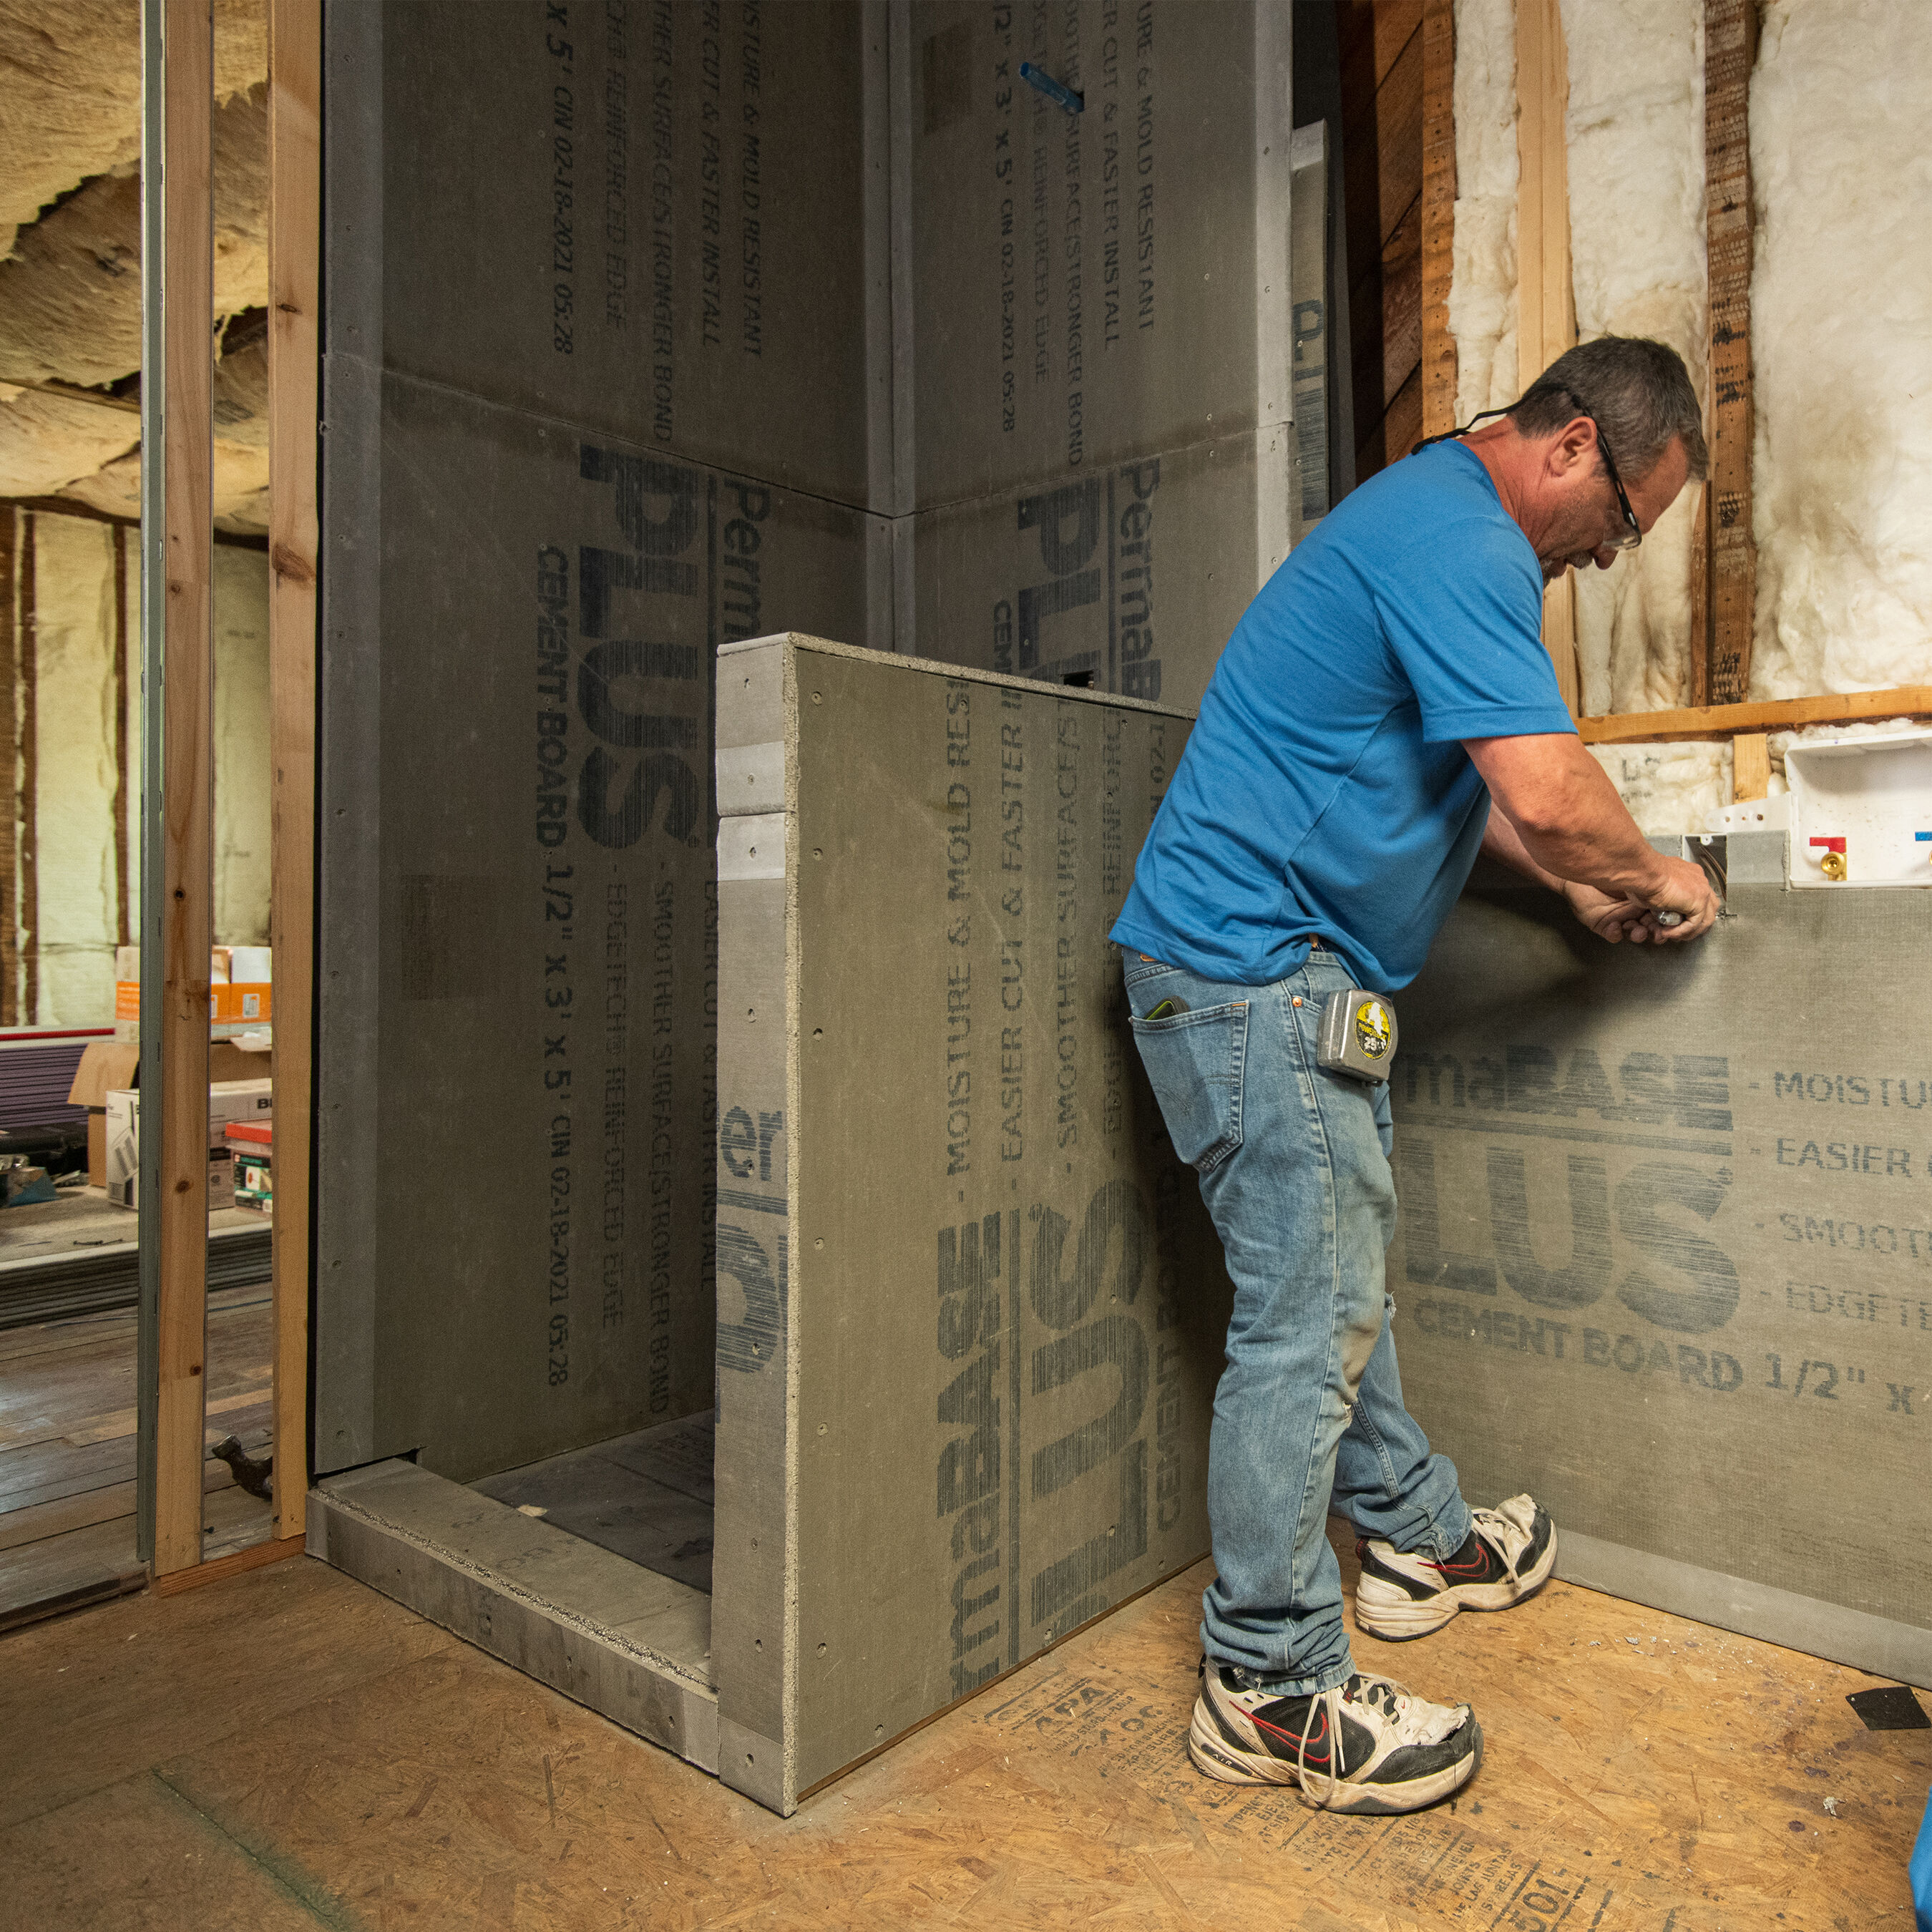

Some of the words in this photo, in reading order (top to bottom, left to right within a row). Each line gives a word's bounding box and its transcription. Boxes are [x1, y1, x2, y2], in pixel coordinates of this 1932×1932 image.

[702, 37, 720, 97] CUT
[743, 0, 761, 99] ISTURE
[1103, 36, 1118, 88] CUT
[702, 130, 721, 236] FASTER
[743, 132, 761, 211] MOLD
[1103, 130, 1119, 234] FASTER
[1137, 94, 1154, 176] MOLD
[554, 136, 573, 273] 02-18-2021
[1136, 182, 1154, 331] RESISTANT
[554, 283, 573, 355] 05:28
[606, 253, 626, 331] EDGE
[702, 240, 721, 348] INSTALL
[743, 216, 761, 358] RESISTANT
[1001, 242, 1015, 362] 02-18-2021
[1103, 240, 1121, 351] INSTALL
[653, 364, 673, 442] BOND
[1002, 370, 1015, 432] 05:28
[1067, 391, 1083, 465] BOND
[723, 477, 771, 643] Perm
[537, 545, 568, 703] CEMENT
[577, 444, 699, 849] PLUS
[537, 711, 568, 848] BOARD
[1002, 723, 1023, 872] FASTER
[947, 782, 971, 902] MOLD
[653, 881, 673, 1036] SMOOTHER
[1002, 939, 1023, 1011] CUT
[946, 962, 971, 1176] MOISTURE
[1002, 1026, 1023, 1162] EASIER
[1057, 932, 1077, 1149] SMOOTHER
[1776, 1136, 1913, 1178] EASIER
[549, 1166, 571, 1307] 02-18-2021
[602, 1252, 623, 1329] EDGE
[548, 1314, 570, 1387] 05:28
[649, 1334, 670, 1415] BOND
[1413, 1297, 1571, 1360] CEMENT
[1581, 1326, 1744, 1392] BOARD
[1030, 1178, 1149, 1646] LUS
